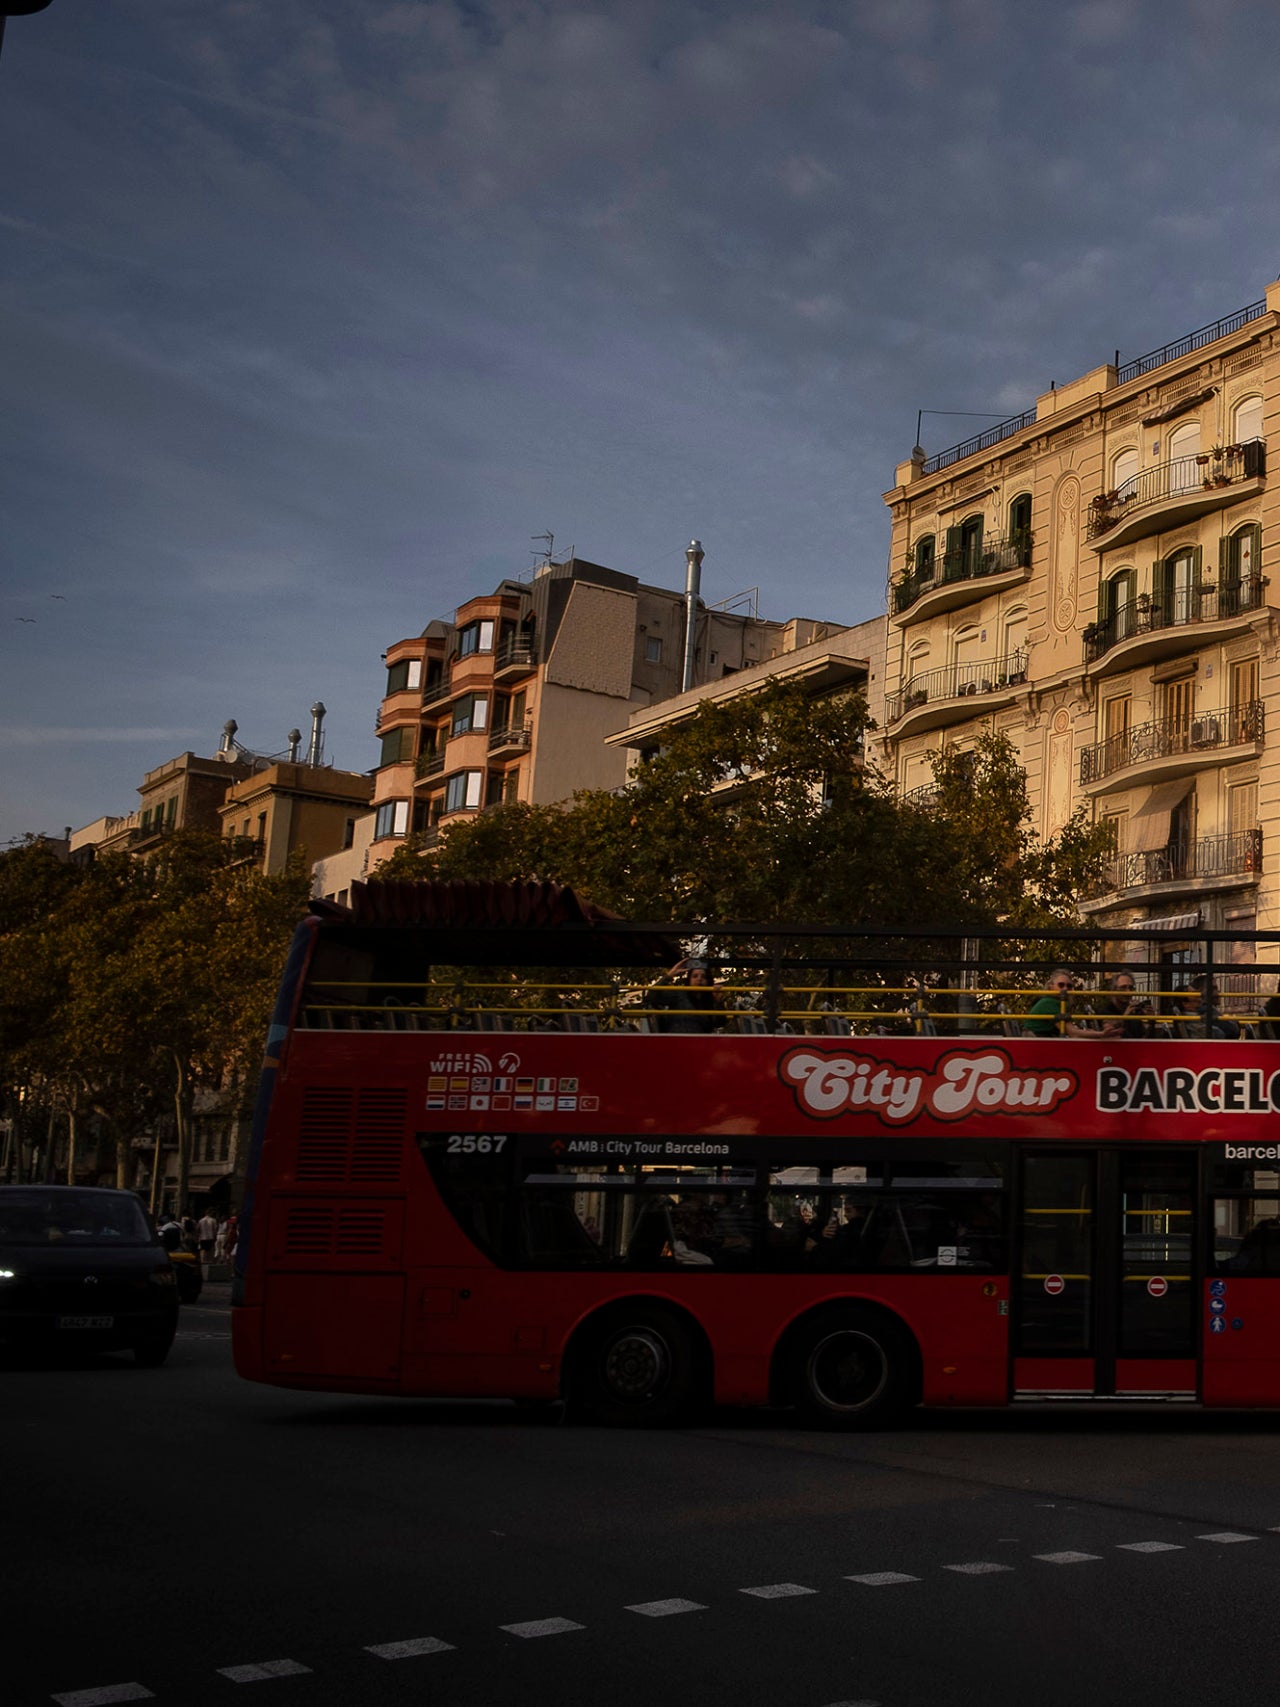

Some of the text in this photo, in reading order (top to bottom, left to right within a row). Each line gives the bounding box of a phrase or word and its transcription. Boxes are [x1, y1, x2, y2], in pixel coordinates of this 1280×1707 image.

[429, 1061, 470, 1073] WIFI
[787, 1054, 1070, 1118] City Tour
[446, 1135, 508, 1153] 2567
[568, 1140, 729, 1156] AMB City Tour Barcelona
